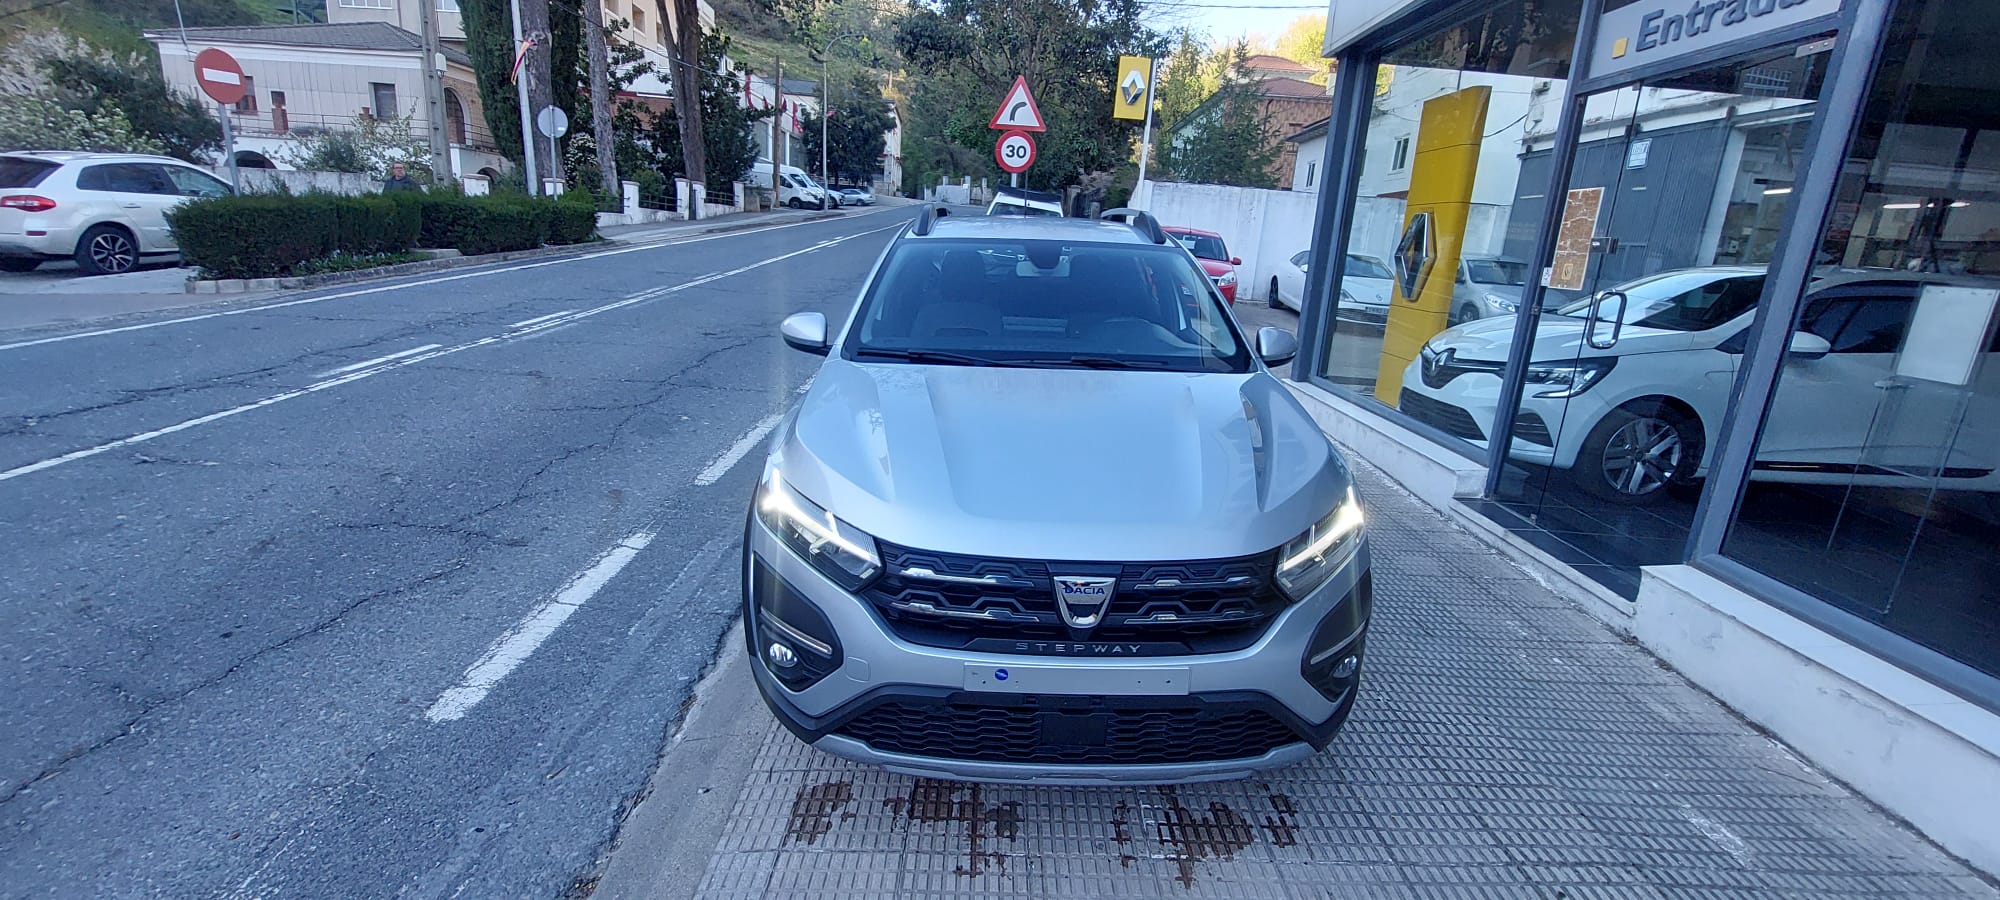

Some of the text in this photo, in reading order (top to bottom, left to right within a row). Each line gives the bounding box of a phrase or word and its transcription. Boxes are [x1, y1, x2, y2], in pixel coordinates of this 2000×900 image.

[1005, 144, 1027, 159] 30
[1063, 584, 1105, 595] DACIA
[1015, 642, 1141, 653] STEPWAY
